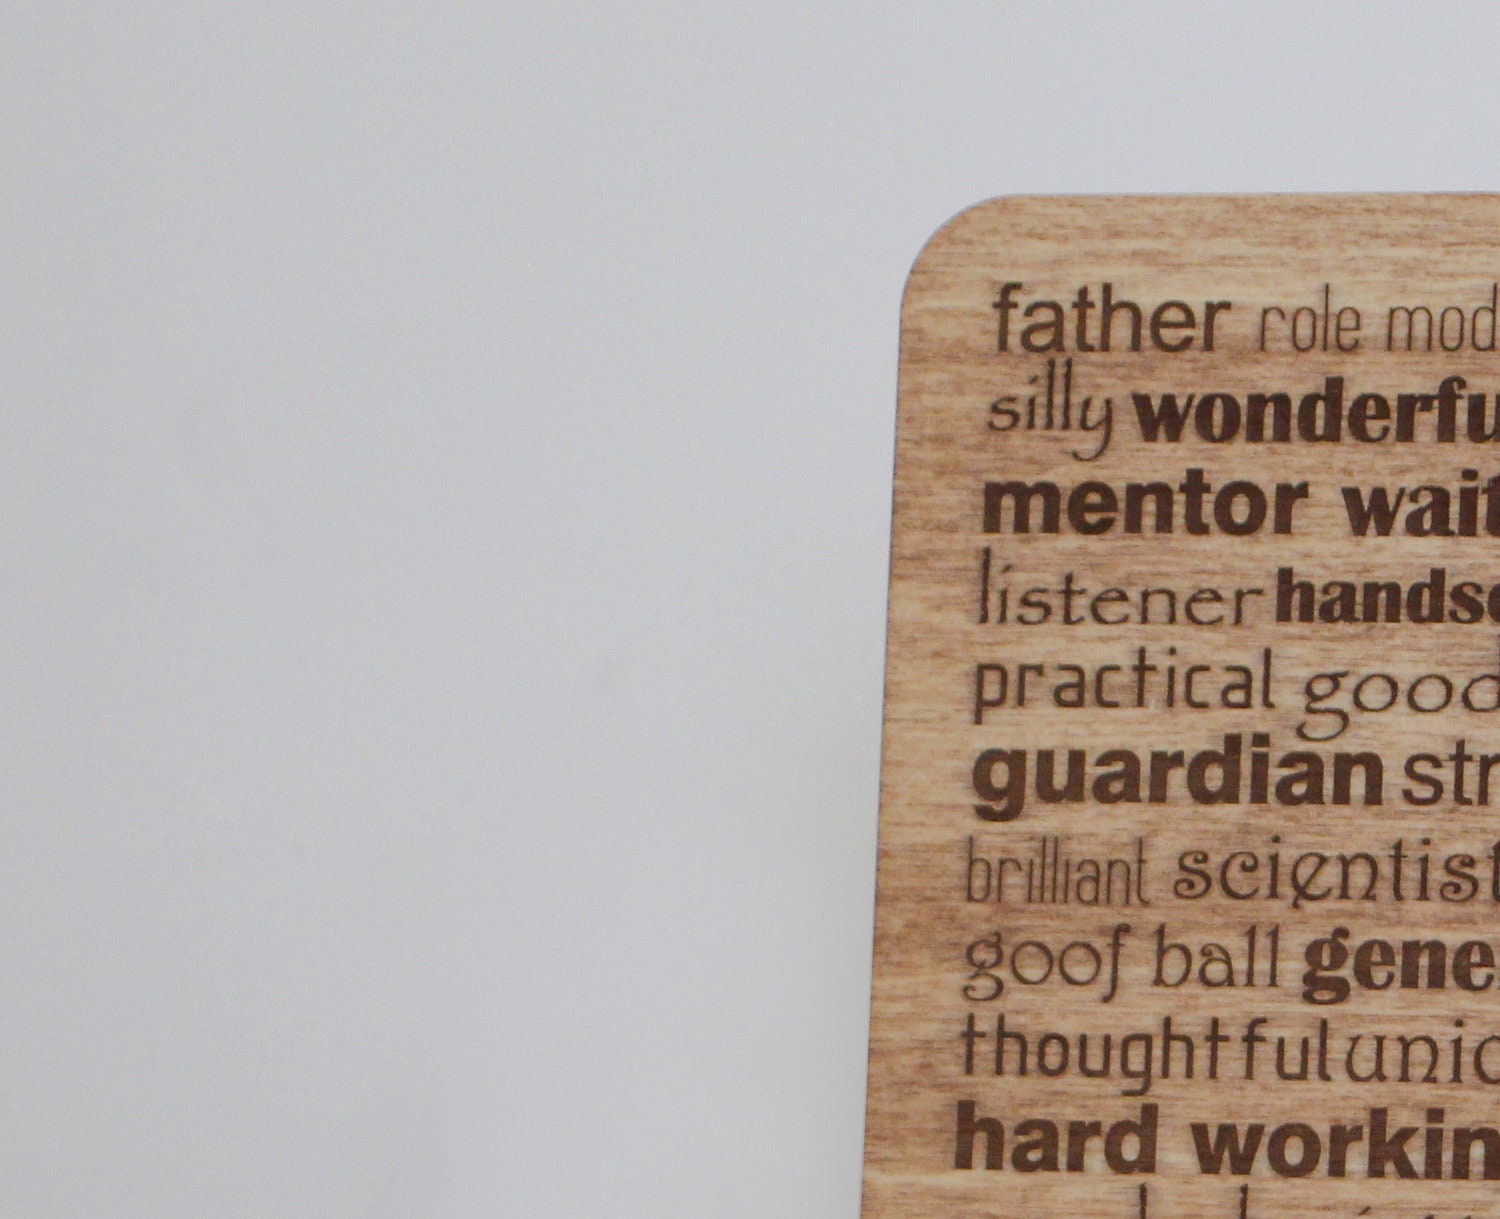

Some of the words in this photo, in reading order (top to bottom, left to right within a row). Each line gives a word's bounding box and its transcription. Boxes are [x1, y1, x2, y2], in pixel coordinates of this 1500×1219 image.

[992, 282, 1231, 353] father
[1260, 282, 1360, 352] role
[988, 358, 1113, 461] silly
[983, 468, 1309, 535] mentor
[978, 546, 1265, 625] listener
[971, 646, 1276, 724] practical
[972, 734, 1384, 821] guardian
[966, 835, 1148, 905] brilliant
[963, 922, 1131, 1003] goof
[1151, 924, 1281, 990] ball
[960, 1013, 1330, 1097] thoughtful
[954, 1101, 1158, 1174] hard
